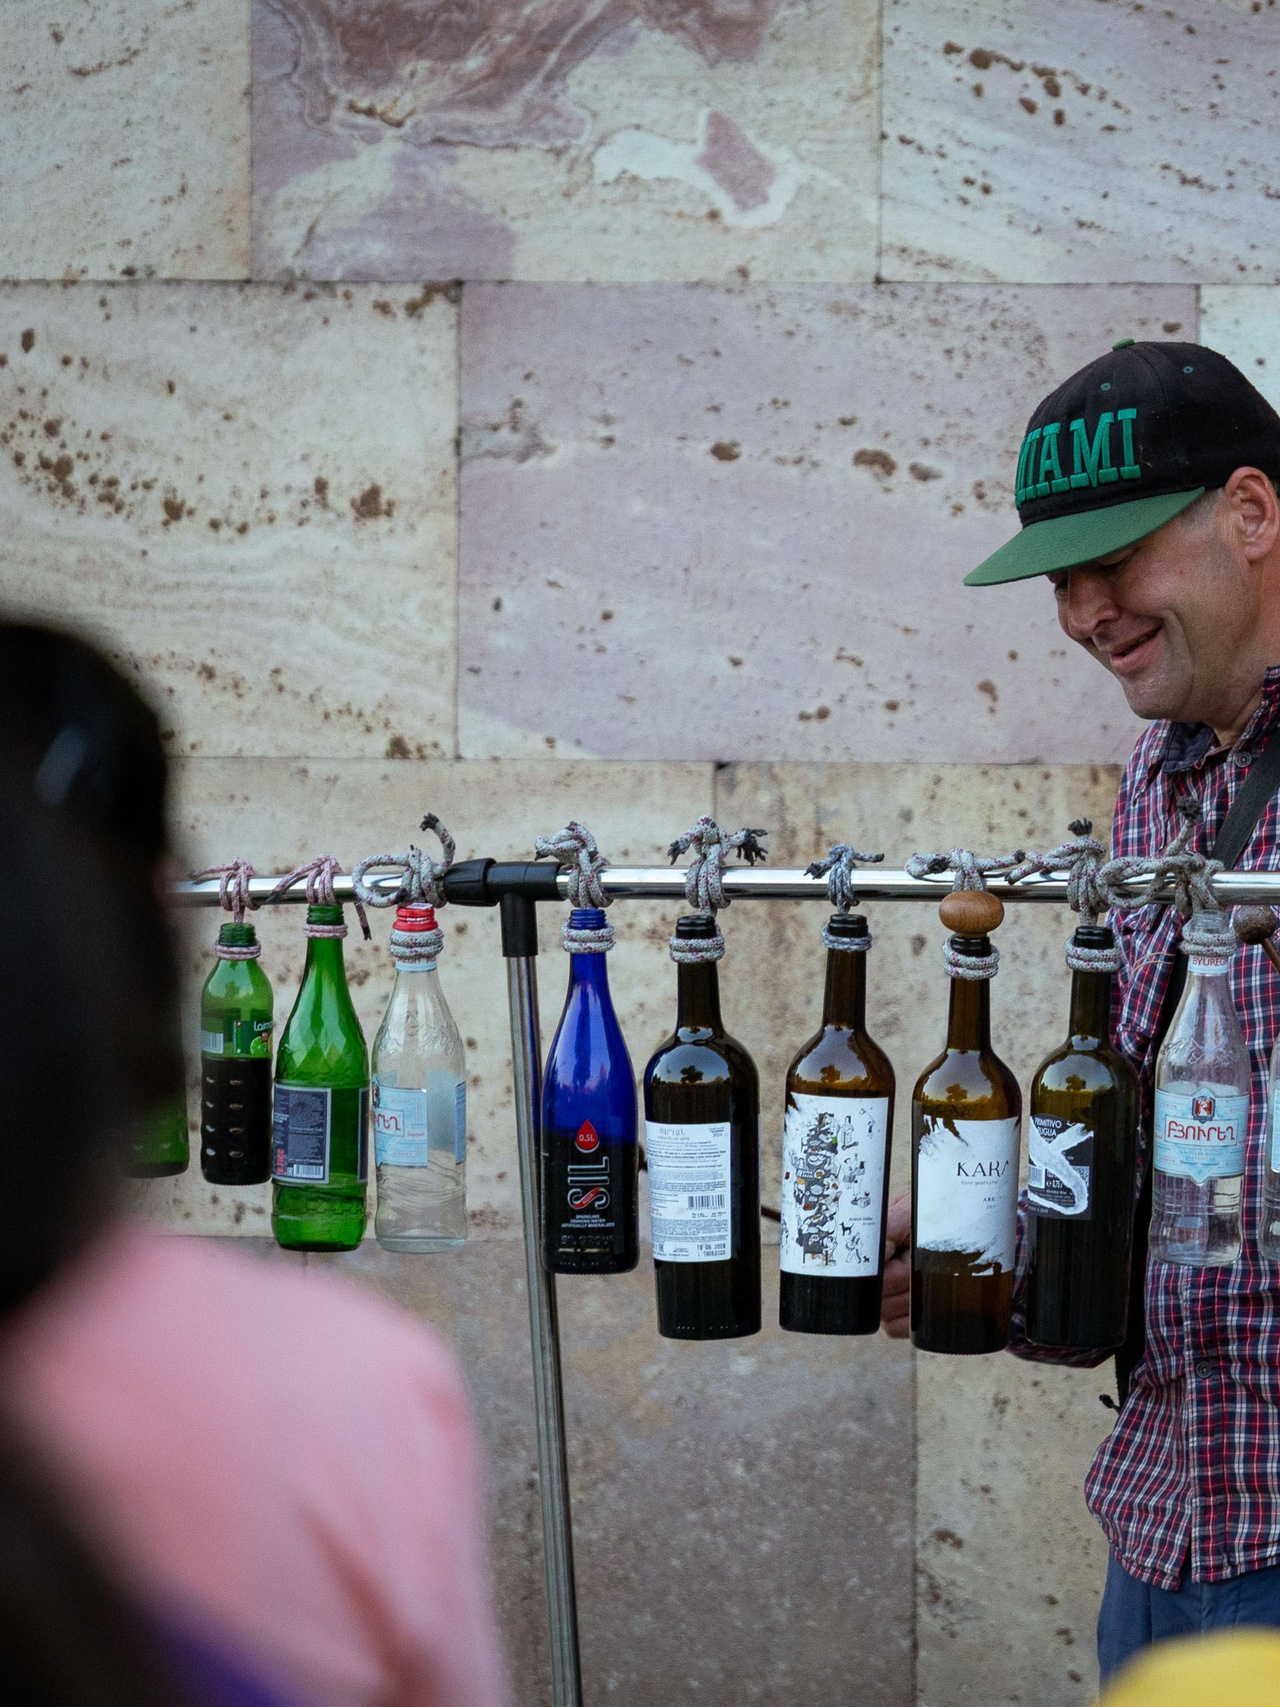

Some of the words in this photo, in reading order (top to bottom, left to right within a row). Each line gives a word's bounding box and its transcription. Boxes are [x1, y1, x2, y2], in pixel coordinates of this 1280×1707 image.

[1192, 956, 1228, 967] BYUREG
[578, 1133, 595, 1142] 0.5L
[567, 1155, 610, 1210] SIL
